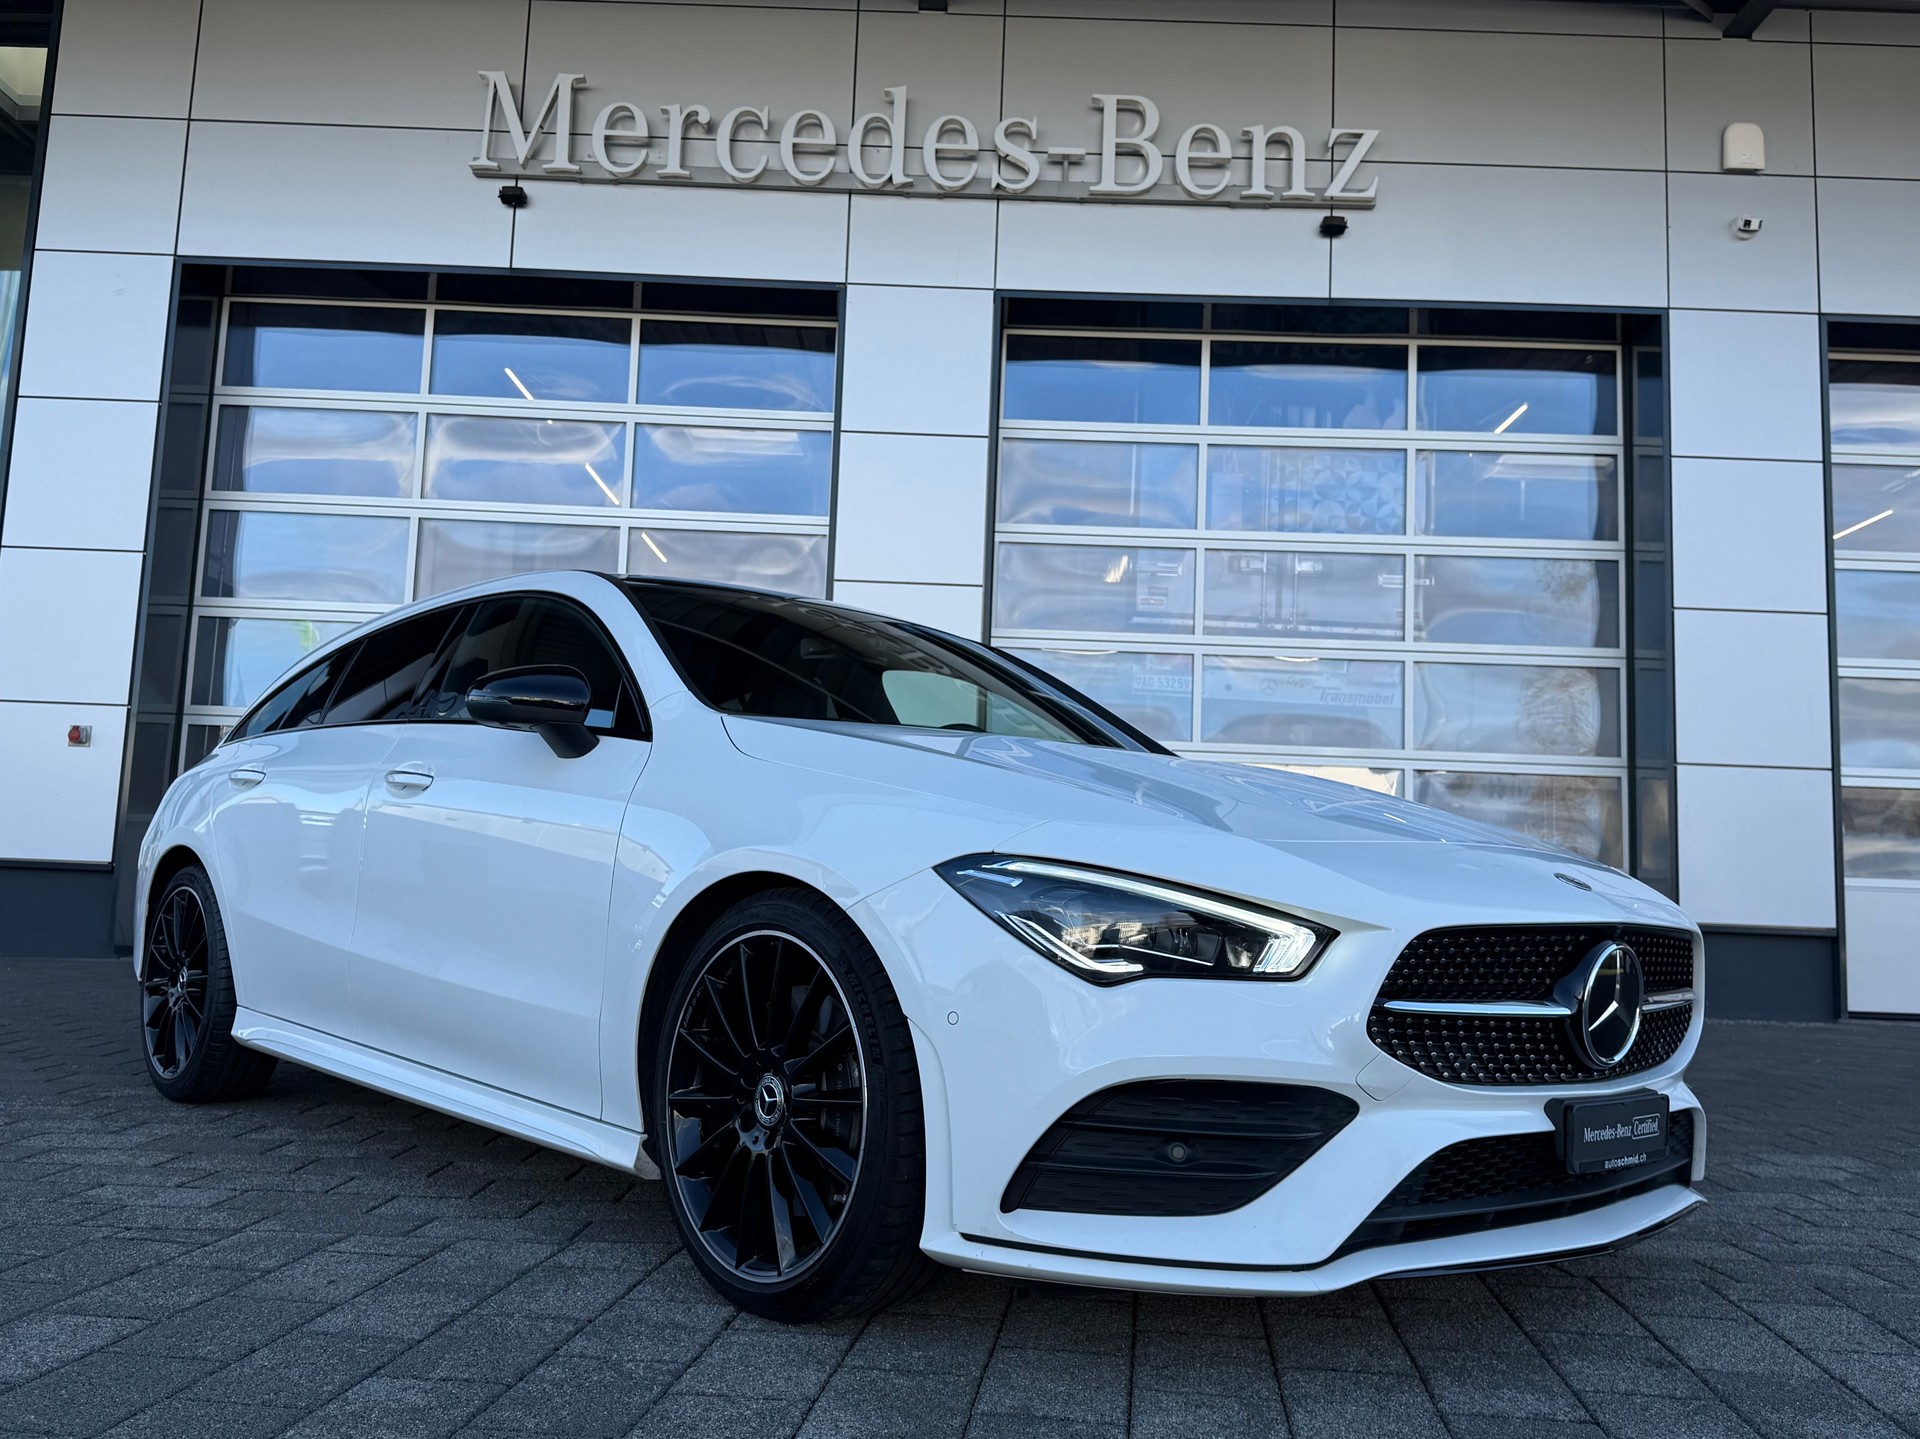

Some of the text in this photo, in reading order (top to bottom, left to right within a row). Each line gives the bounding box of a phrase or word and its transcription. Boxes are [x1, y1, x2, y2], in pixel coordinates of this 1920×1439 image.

[471, 70, 1381, 202] Mercedes-Benz
[846, 972, 883, 1062] MICHELIN
[1583, 1117, 1660, 1143] Mercedes-Benz Certified
[1604, 1152, 1647, 1169] autoschmid.ch
